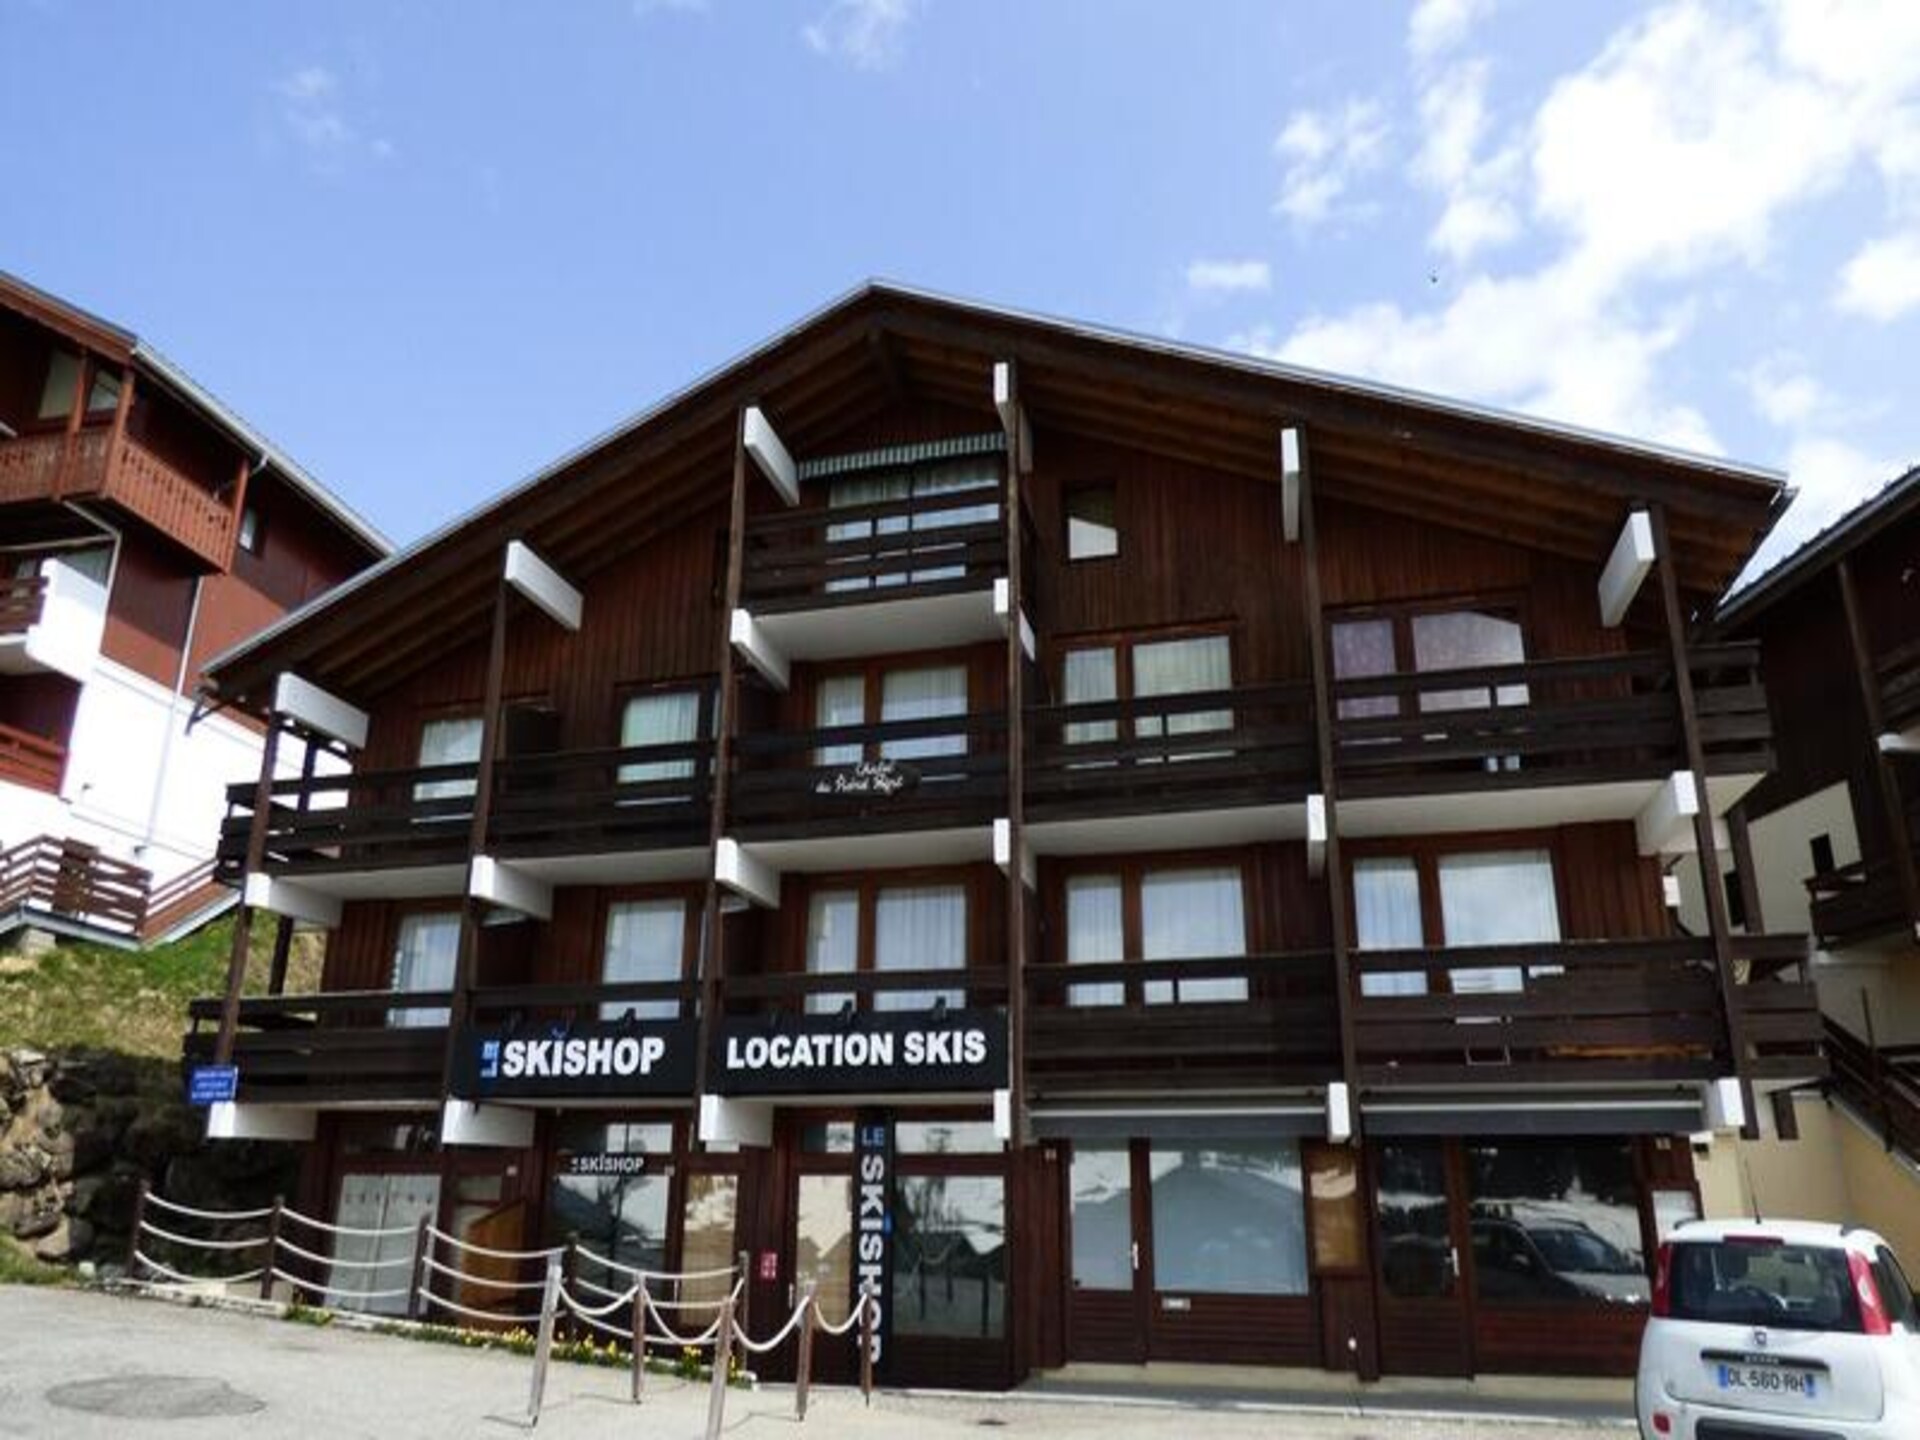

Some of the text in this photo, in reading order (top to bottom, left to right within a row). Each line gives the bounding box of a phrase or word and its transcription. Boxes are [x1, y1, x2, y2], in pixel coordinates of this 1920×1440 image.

[502, 1036, 666, 1078] SKISHOP
[726, 1029, 987, 1069] LOCATION SKIS
[861, 1126, 885, 1147] LE
[579, 1154, 645, 1173] SKISHOP
